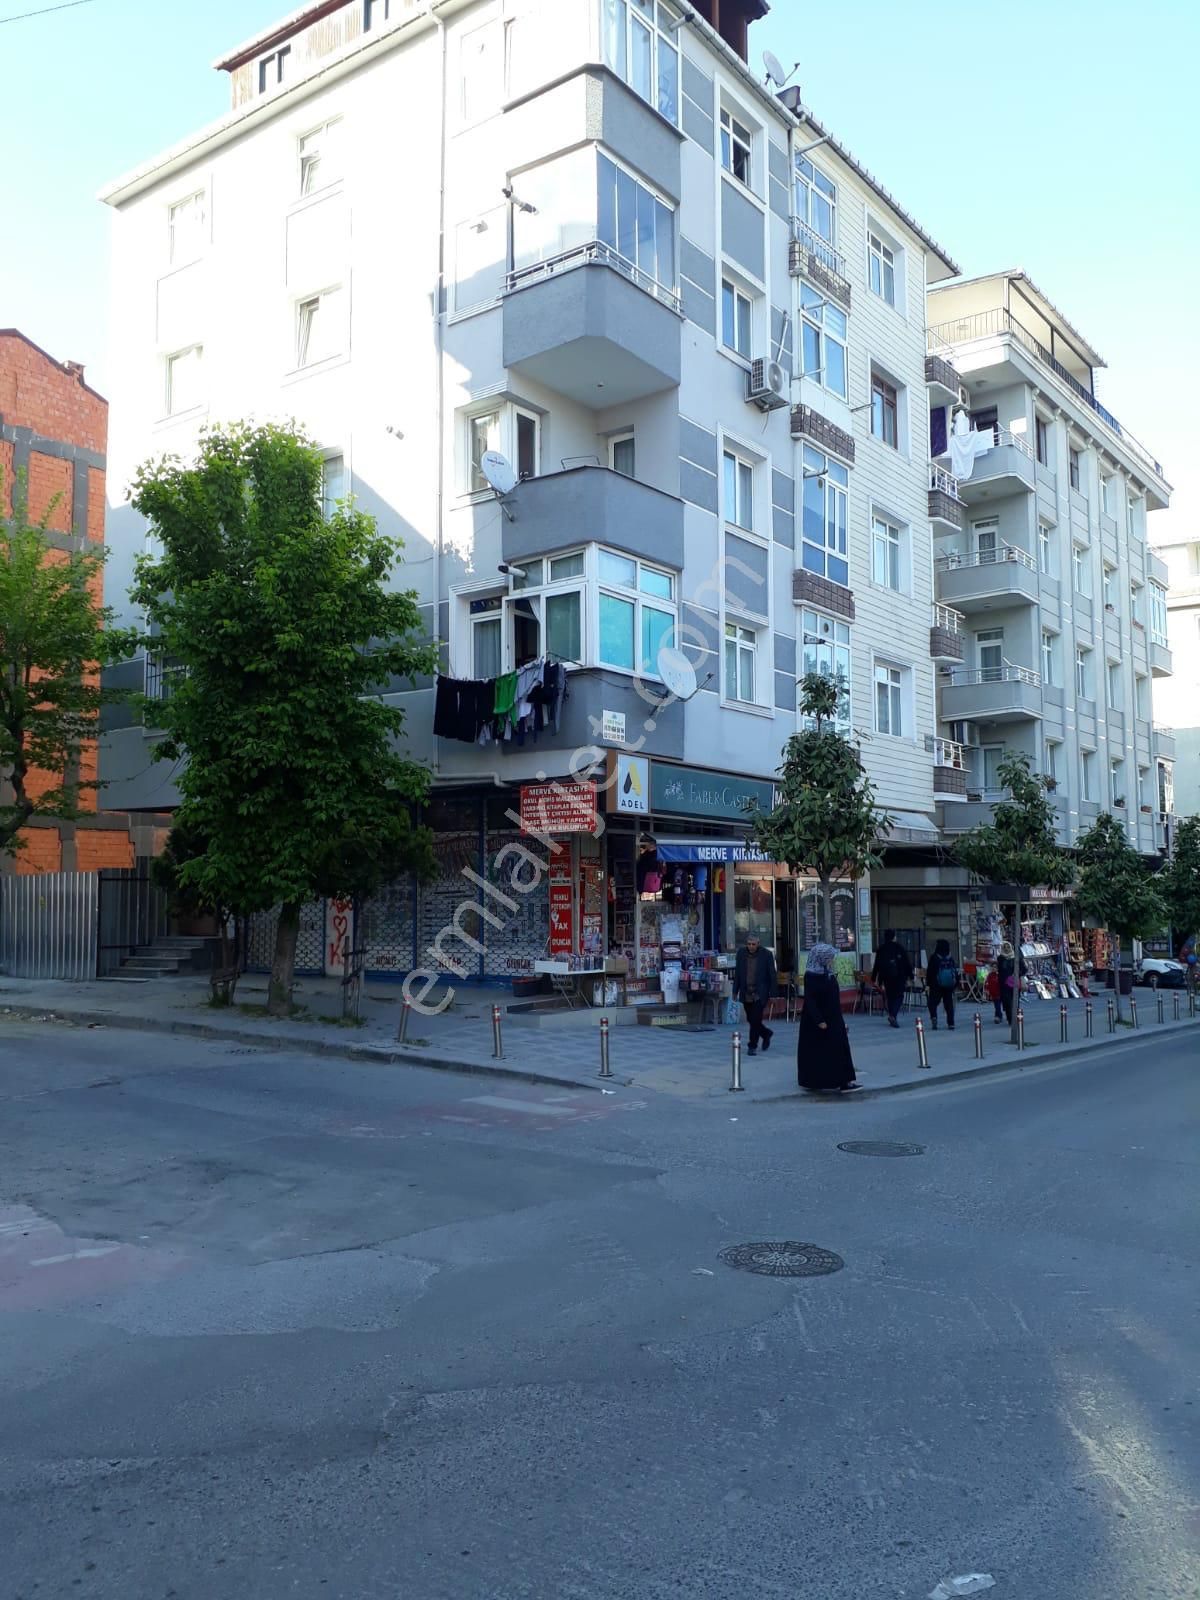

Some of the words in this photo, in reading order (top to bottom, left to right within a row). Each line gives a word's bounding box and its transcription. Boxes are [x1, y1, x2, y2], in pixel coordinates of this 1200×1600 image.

[621, 799, 644, 810] ADEL
[698, 847, 728, 860] MERVE
[554, 922, 568, 930] FAX
